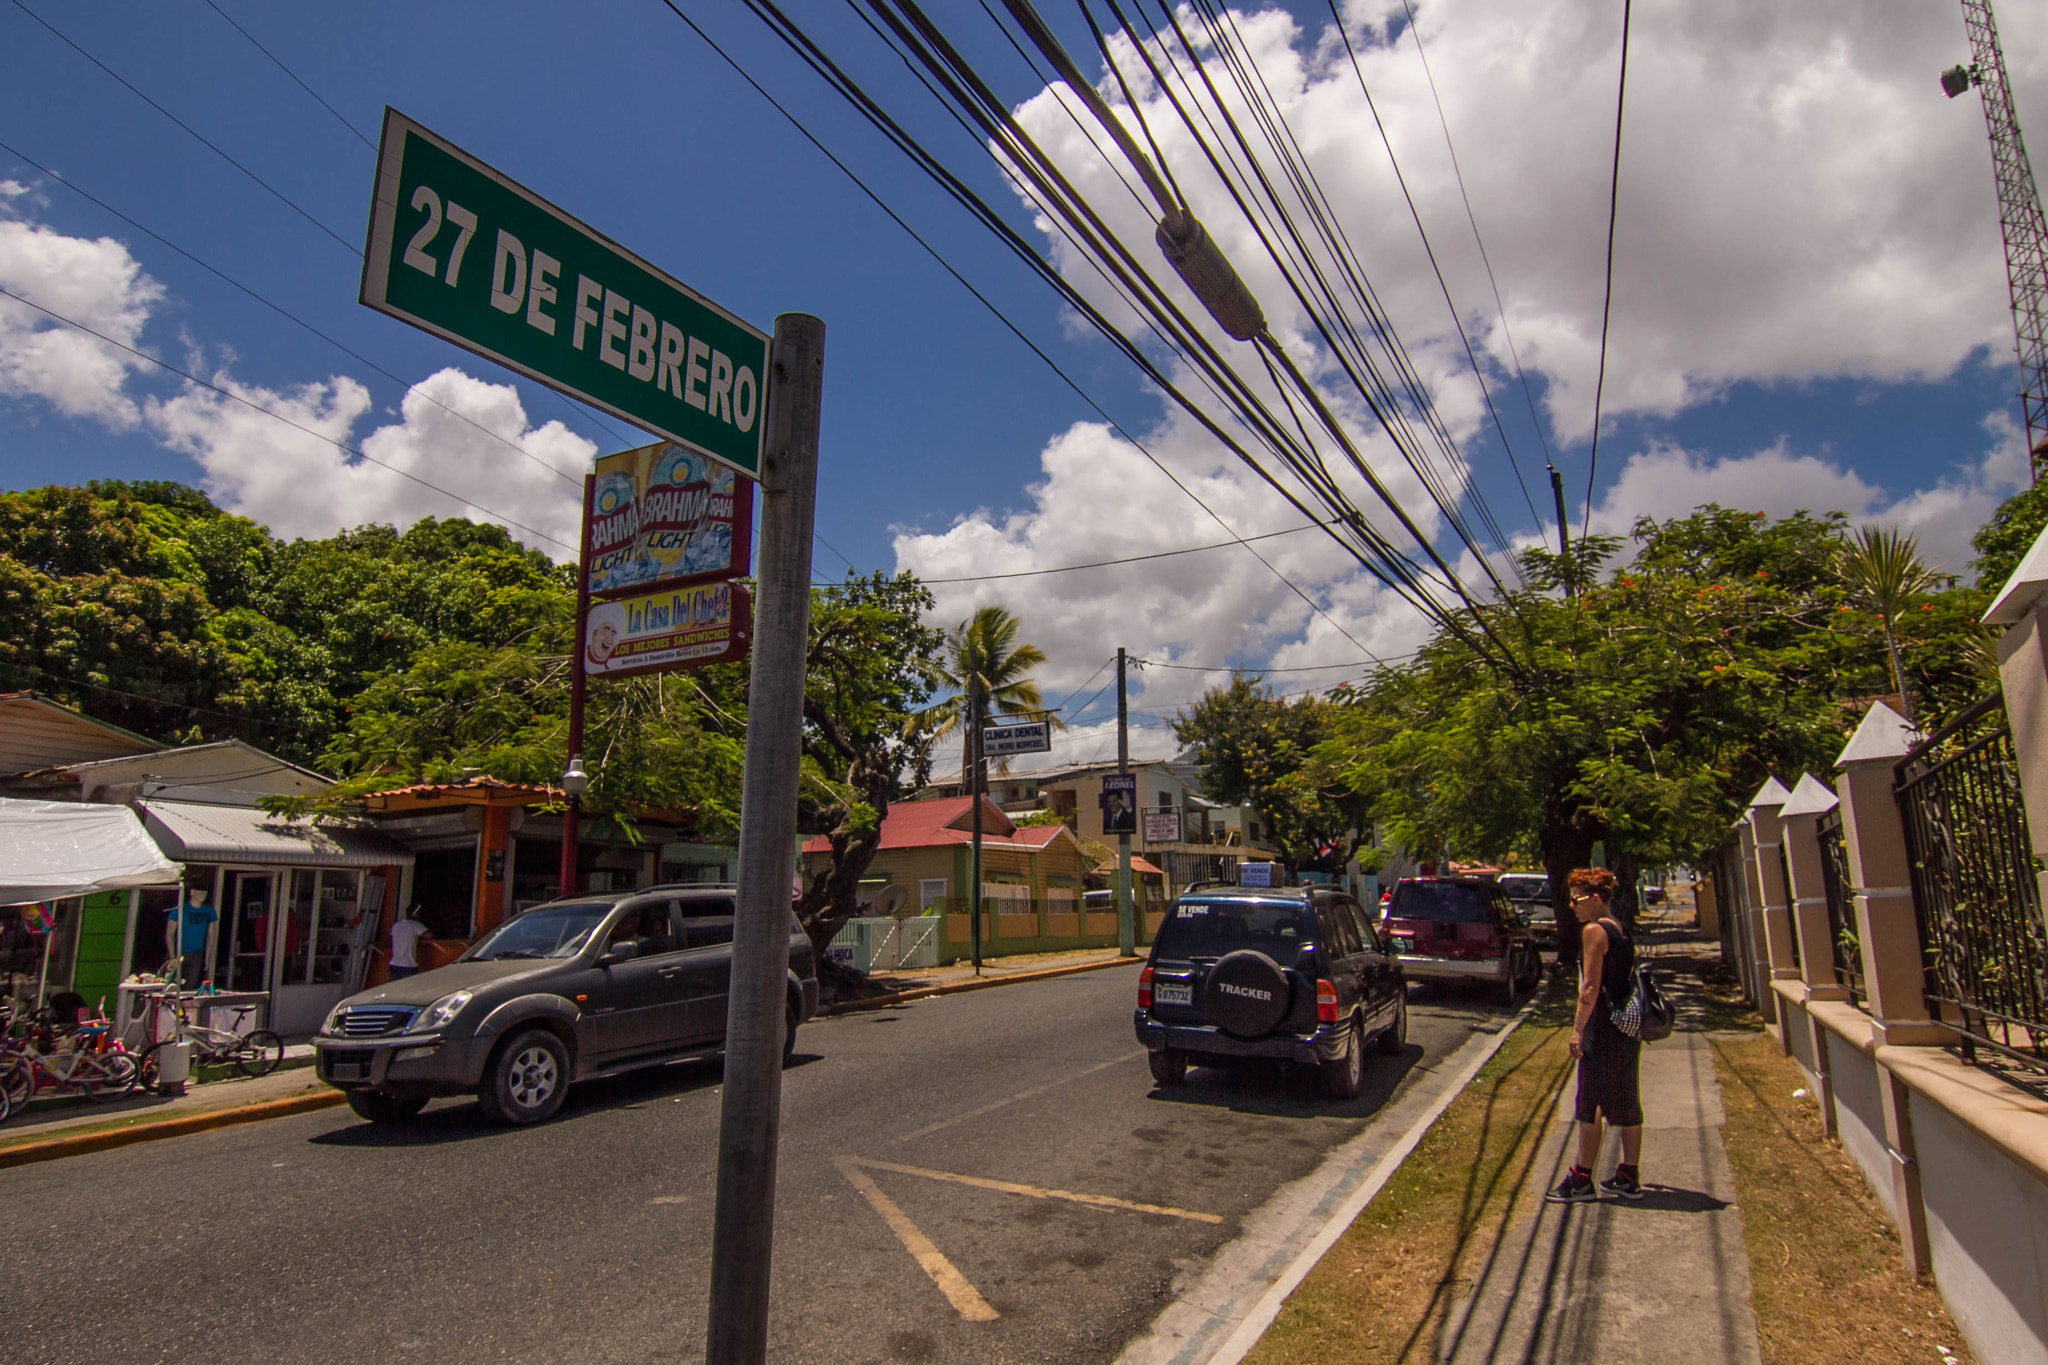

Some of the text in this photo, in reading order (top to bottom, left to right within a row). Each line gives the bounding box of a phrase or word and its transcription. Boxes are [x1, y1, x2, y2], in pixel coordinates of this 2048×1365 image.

[403, 185, 757, 433] 27 DE FEBRERO
[643, 487, 708, 525] BRAHMA
[646, 530, 695, 549] LIGHT
[591, 546, 634, 574] LIGHT
[627, 603, 641, 634] La
[644, 600, 669, 632] Casa
[671, 592, 691, 626] Del
[692, 587, 720, 624] Chef
[614, 628, 730, 656] LOS MEJORES SANDWICHES
[985, 726, 1044, 741] CLINICA DENTAL
[1178, 905, 1209, 914] SE VENDE
[1219, 982, 1272, 1001] TRACKER
